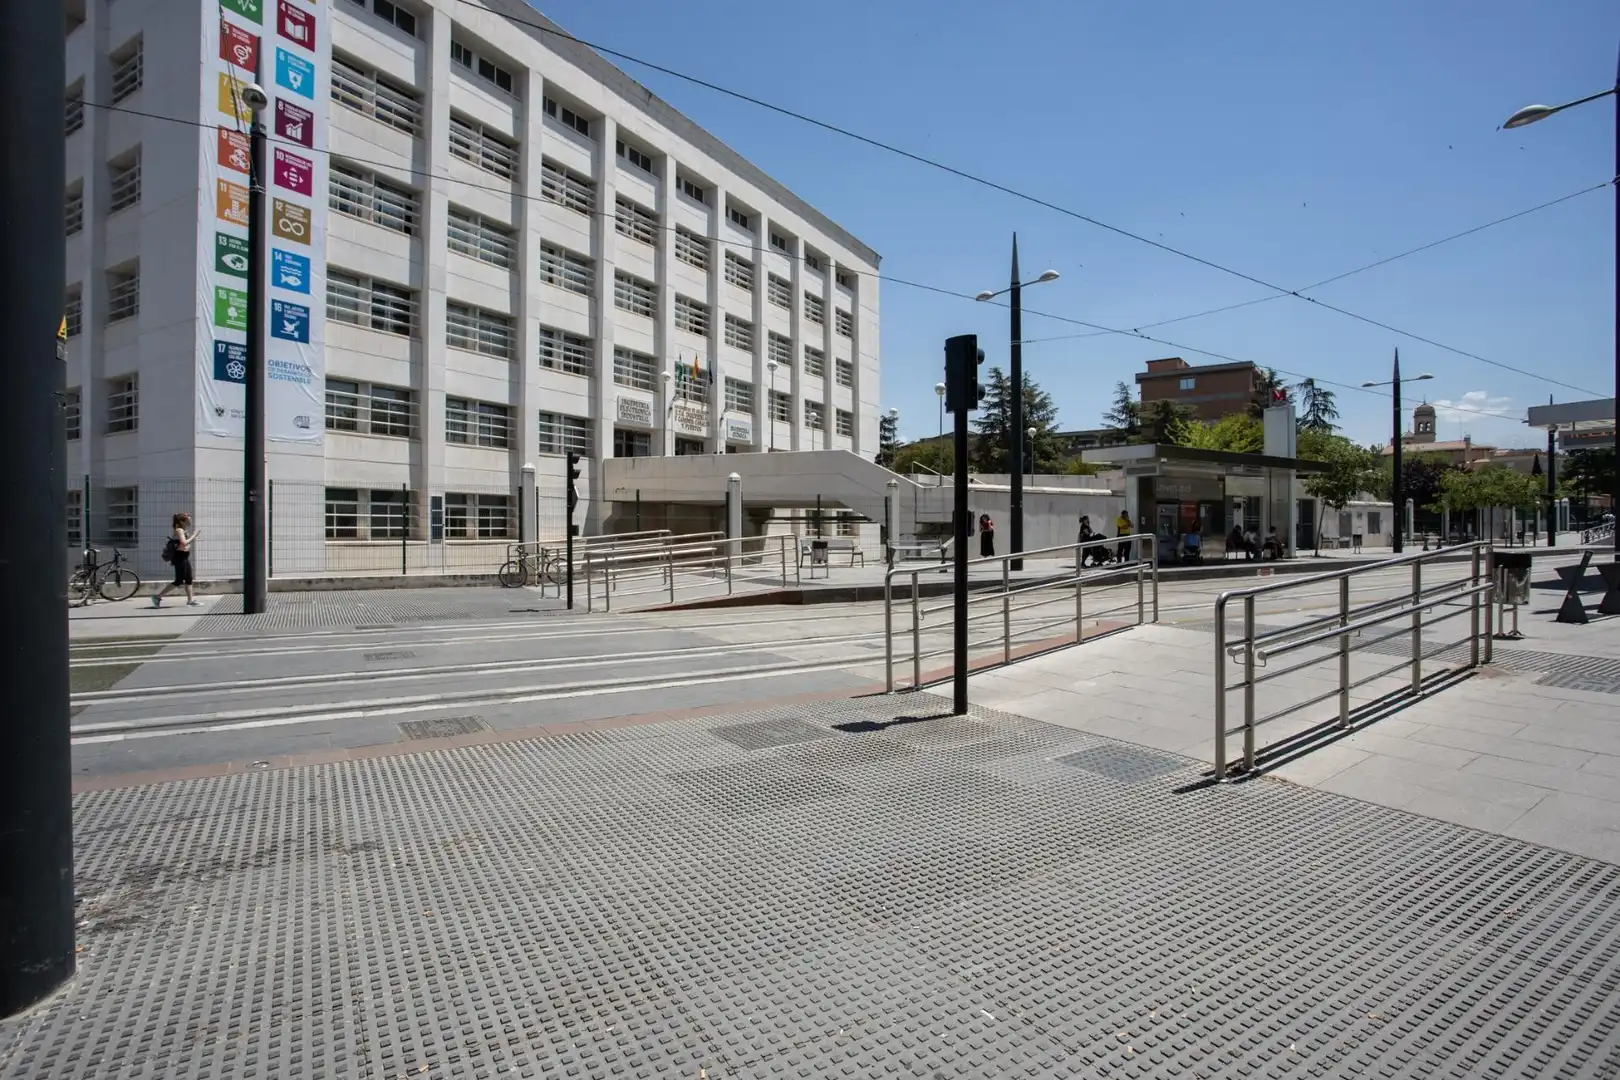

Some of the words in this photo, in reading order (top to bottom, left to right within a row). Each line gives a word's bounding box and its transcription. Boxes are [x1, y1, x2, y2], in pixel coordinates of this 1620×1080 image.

[276, 150, 285, 161] 10
[219, 181, 227, 193] 11
[275, 200, 284, 211] 12
[218, 235, 227, 246] 13
[274, 251, 283, 262] 14
[218, 289, 227, 300] 15
[217, 343, 226, 353] 17
[268, 359, 311, 373] OBJETIVOS
[268, 372, 311, 385] SOSTENIBLE
